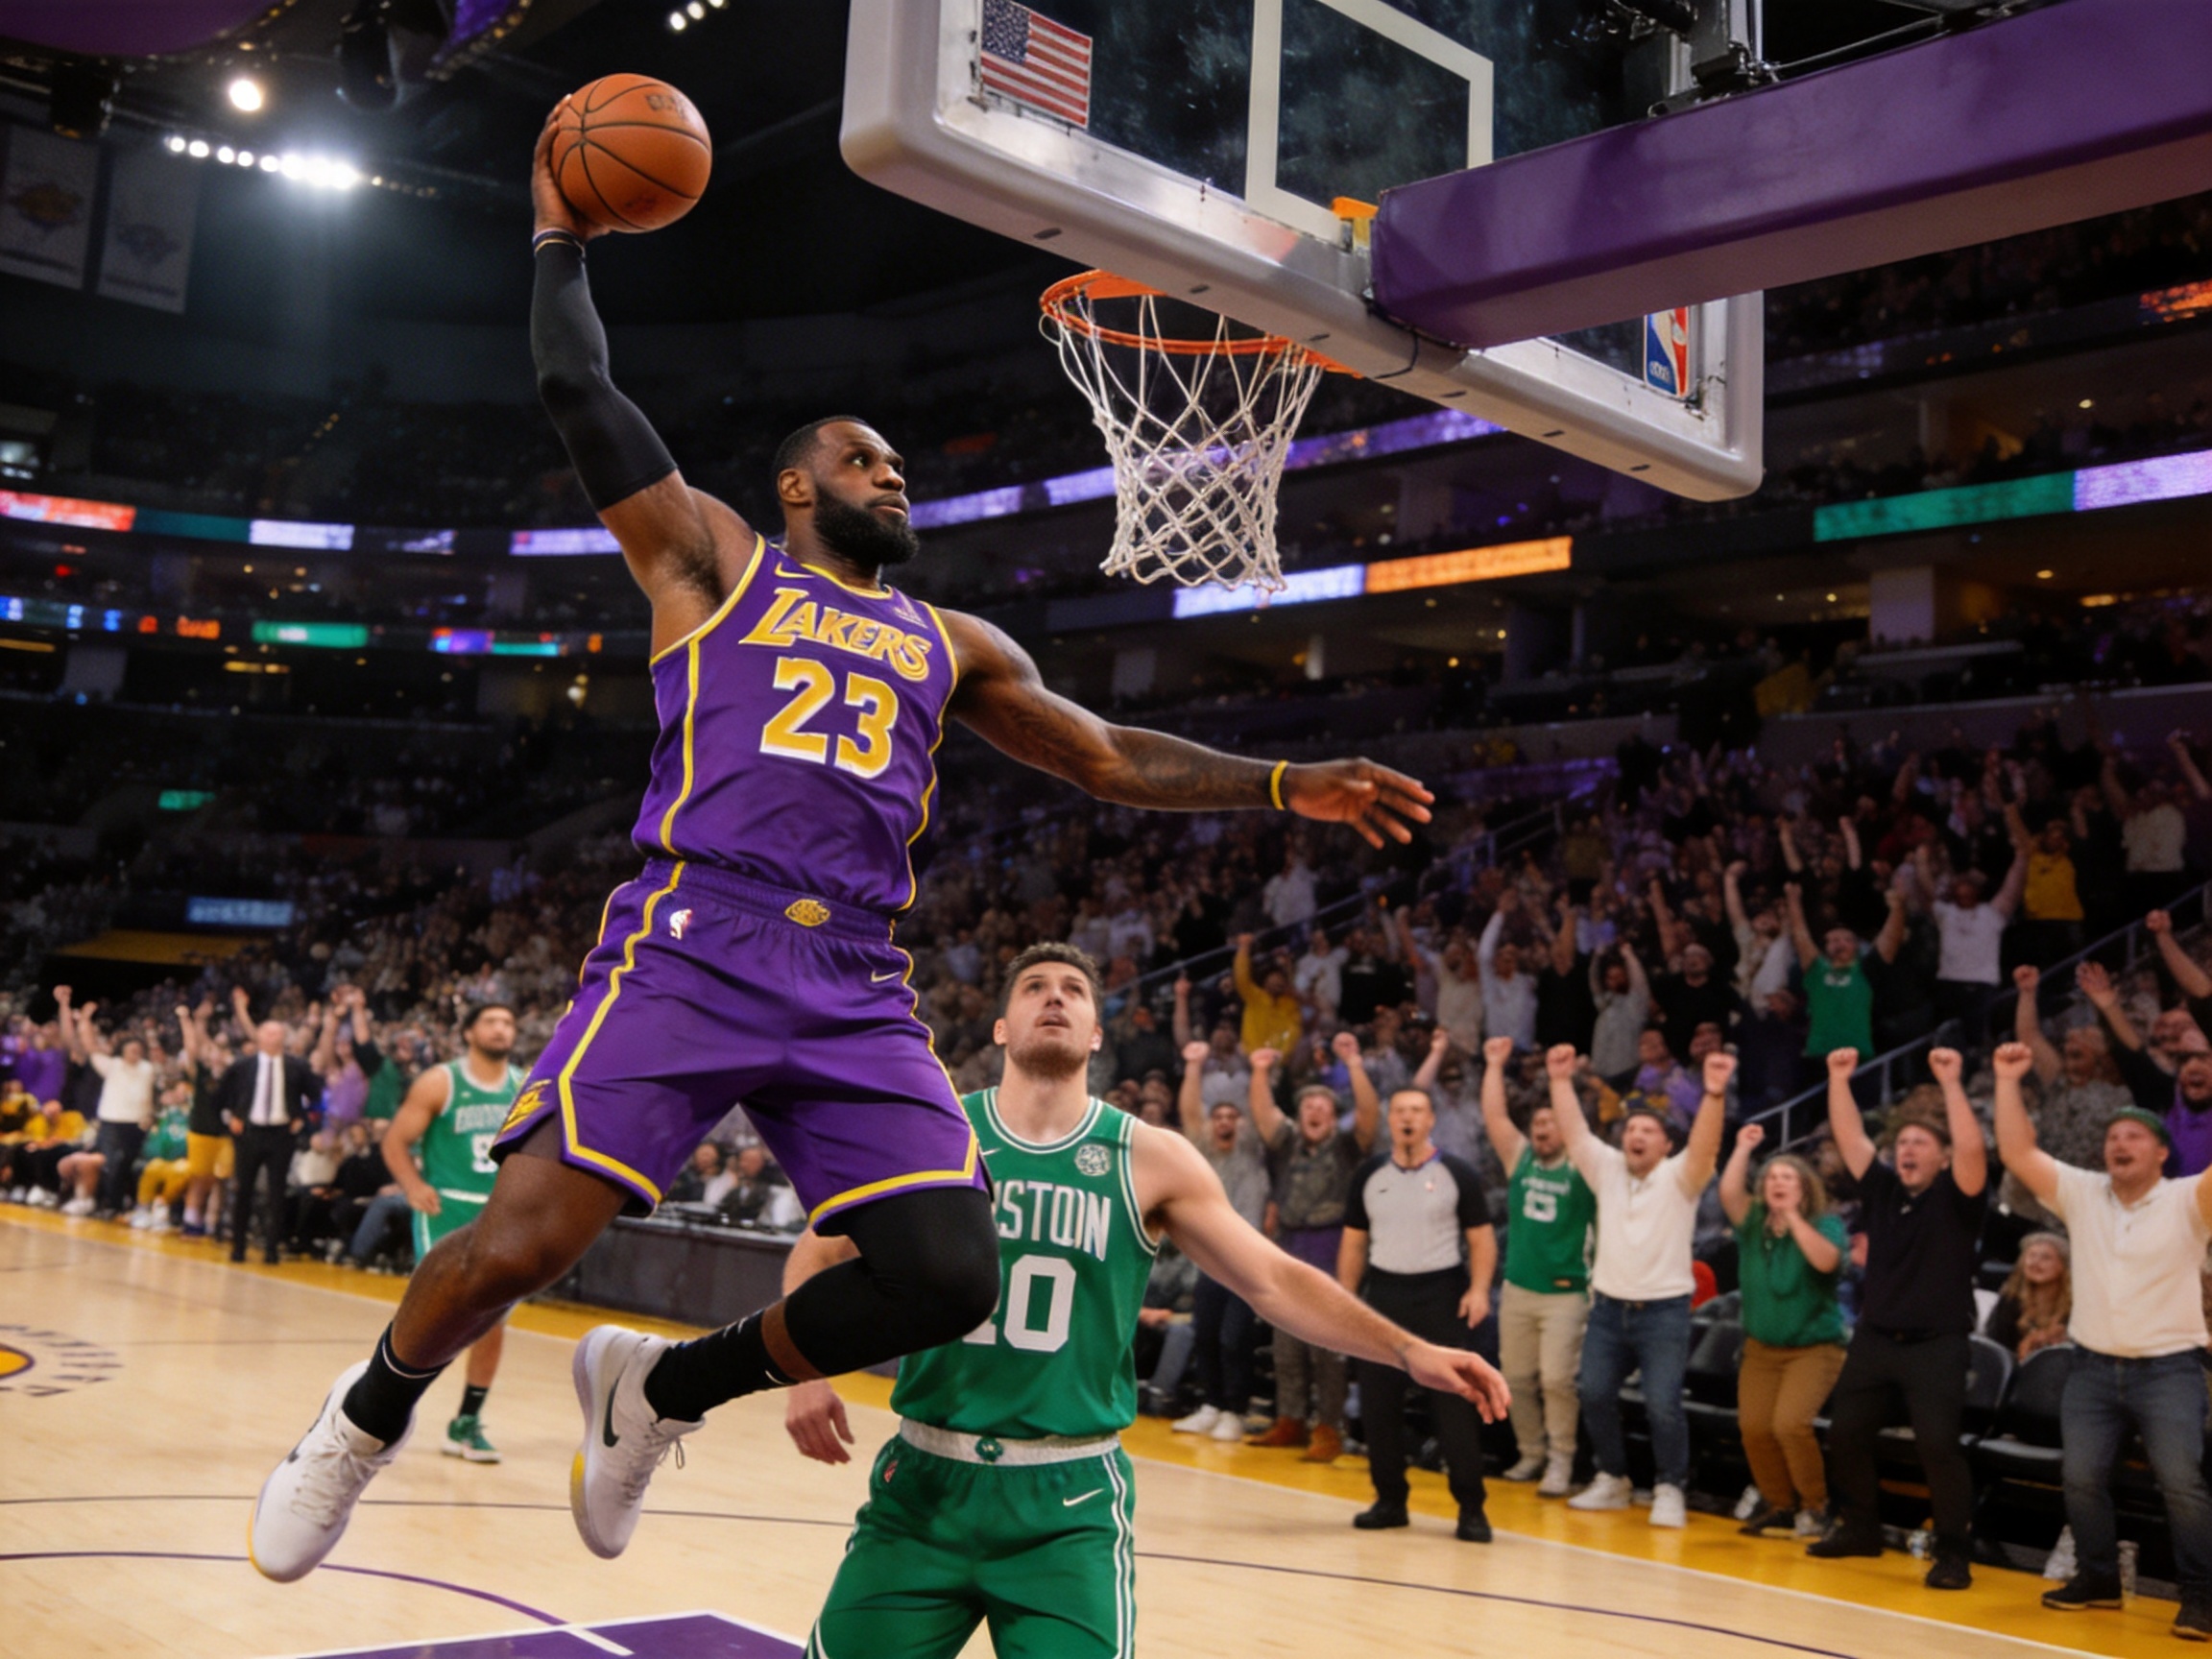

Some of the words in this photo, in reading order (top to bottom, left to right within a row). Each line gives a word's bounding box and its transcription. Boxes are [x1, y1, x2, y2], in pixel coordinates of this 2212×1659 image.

[738, 588, 932, 683] LAKERS
[759, 657, 899, 780] 23
[963, 1254, 1076, 1353] 0
